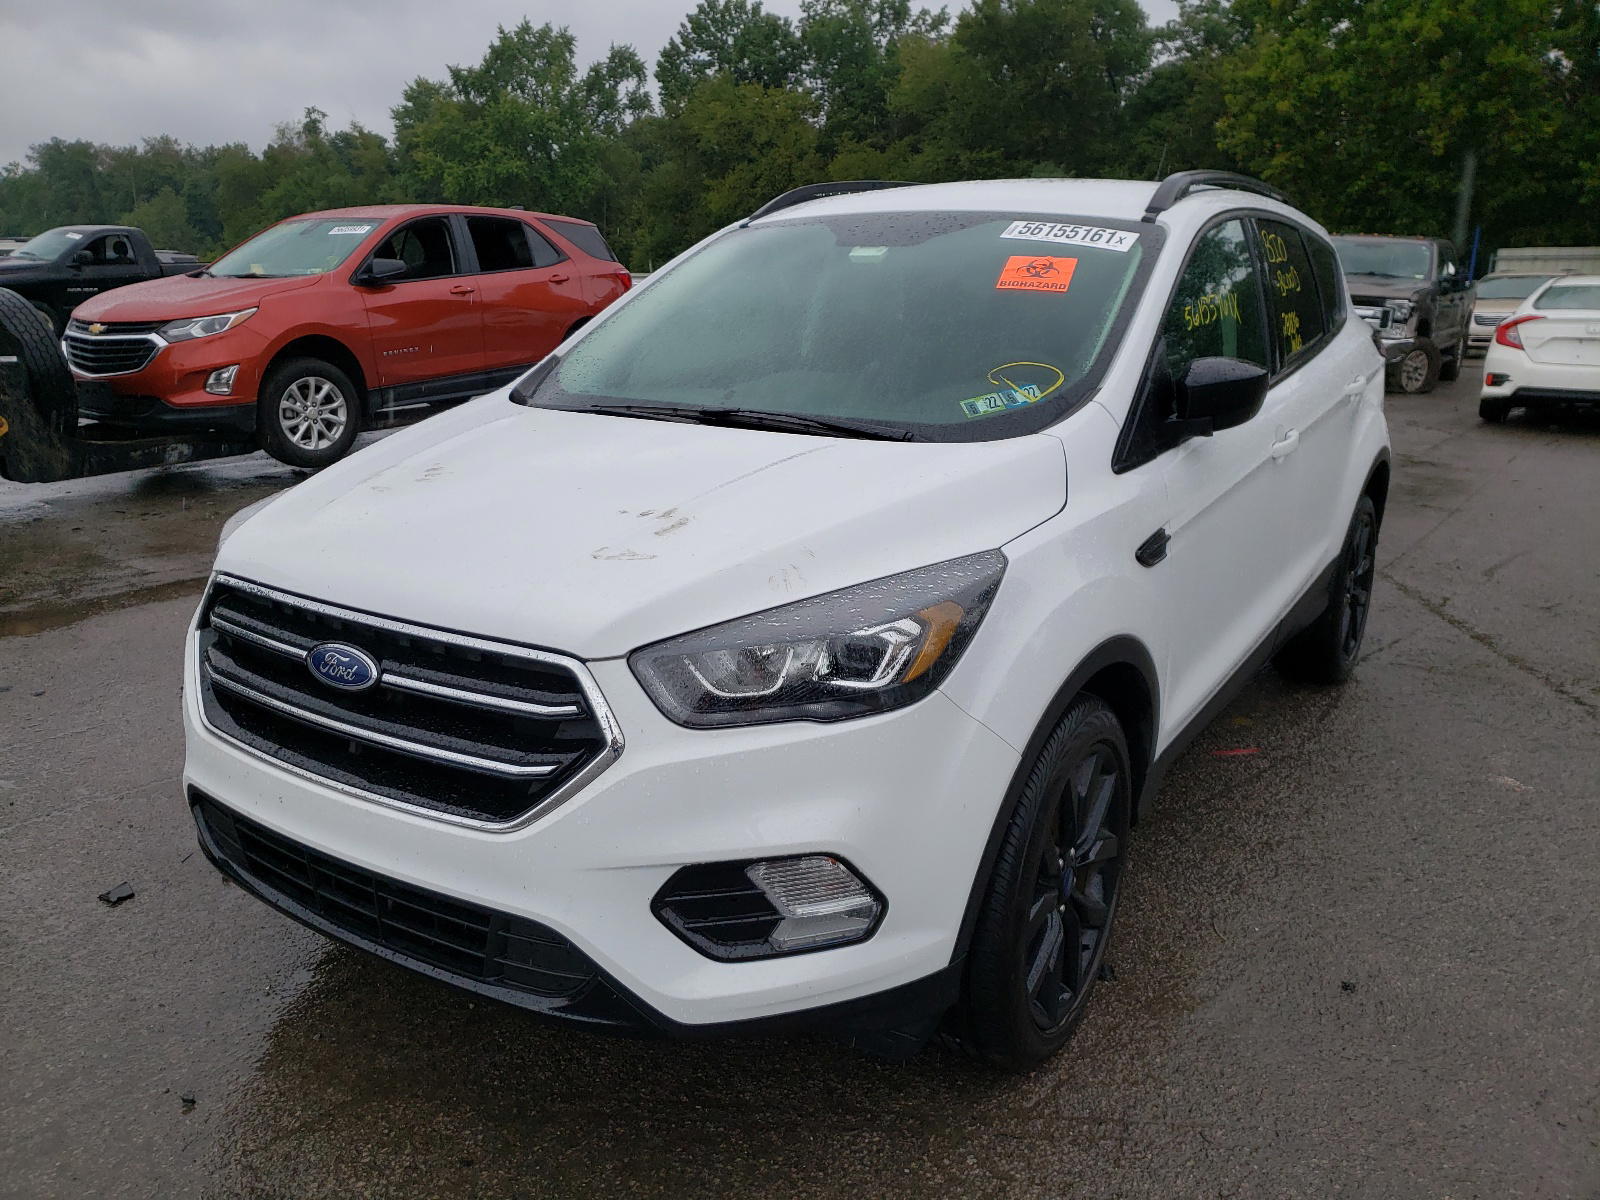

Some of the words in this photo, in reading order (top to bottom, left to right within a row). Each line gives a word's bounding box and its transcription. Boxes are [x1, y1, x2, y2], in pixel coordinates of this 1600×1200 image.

[999, 280, 1067, 290] BIOHAZARD
[985, 396, 1001, 409] 22
[320, 652, 360, 681] Ford
